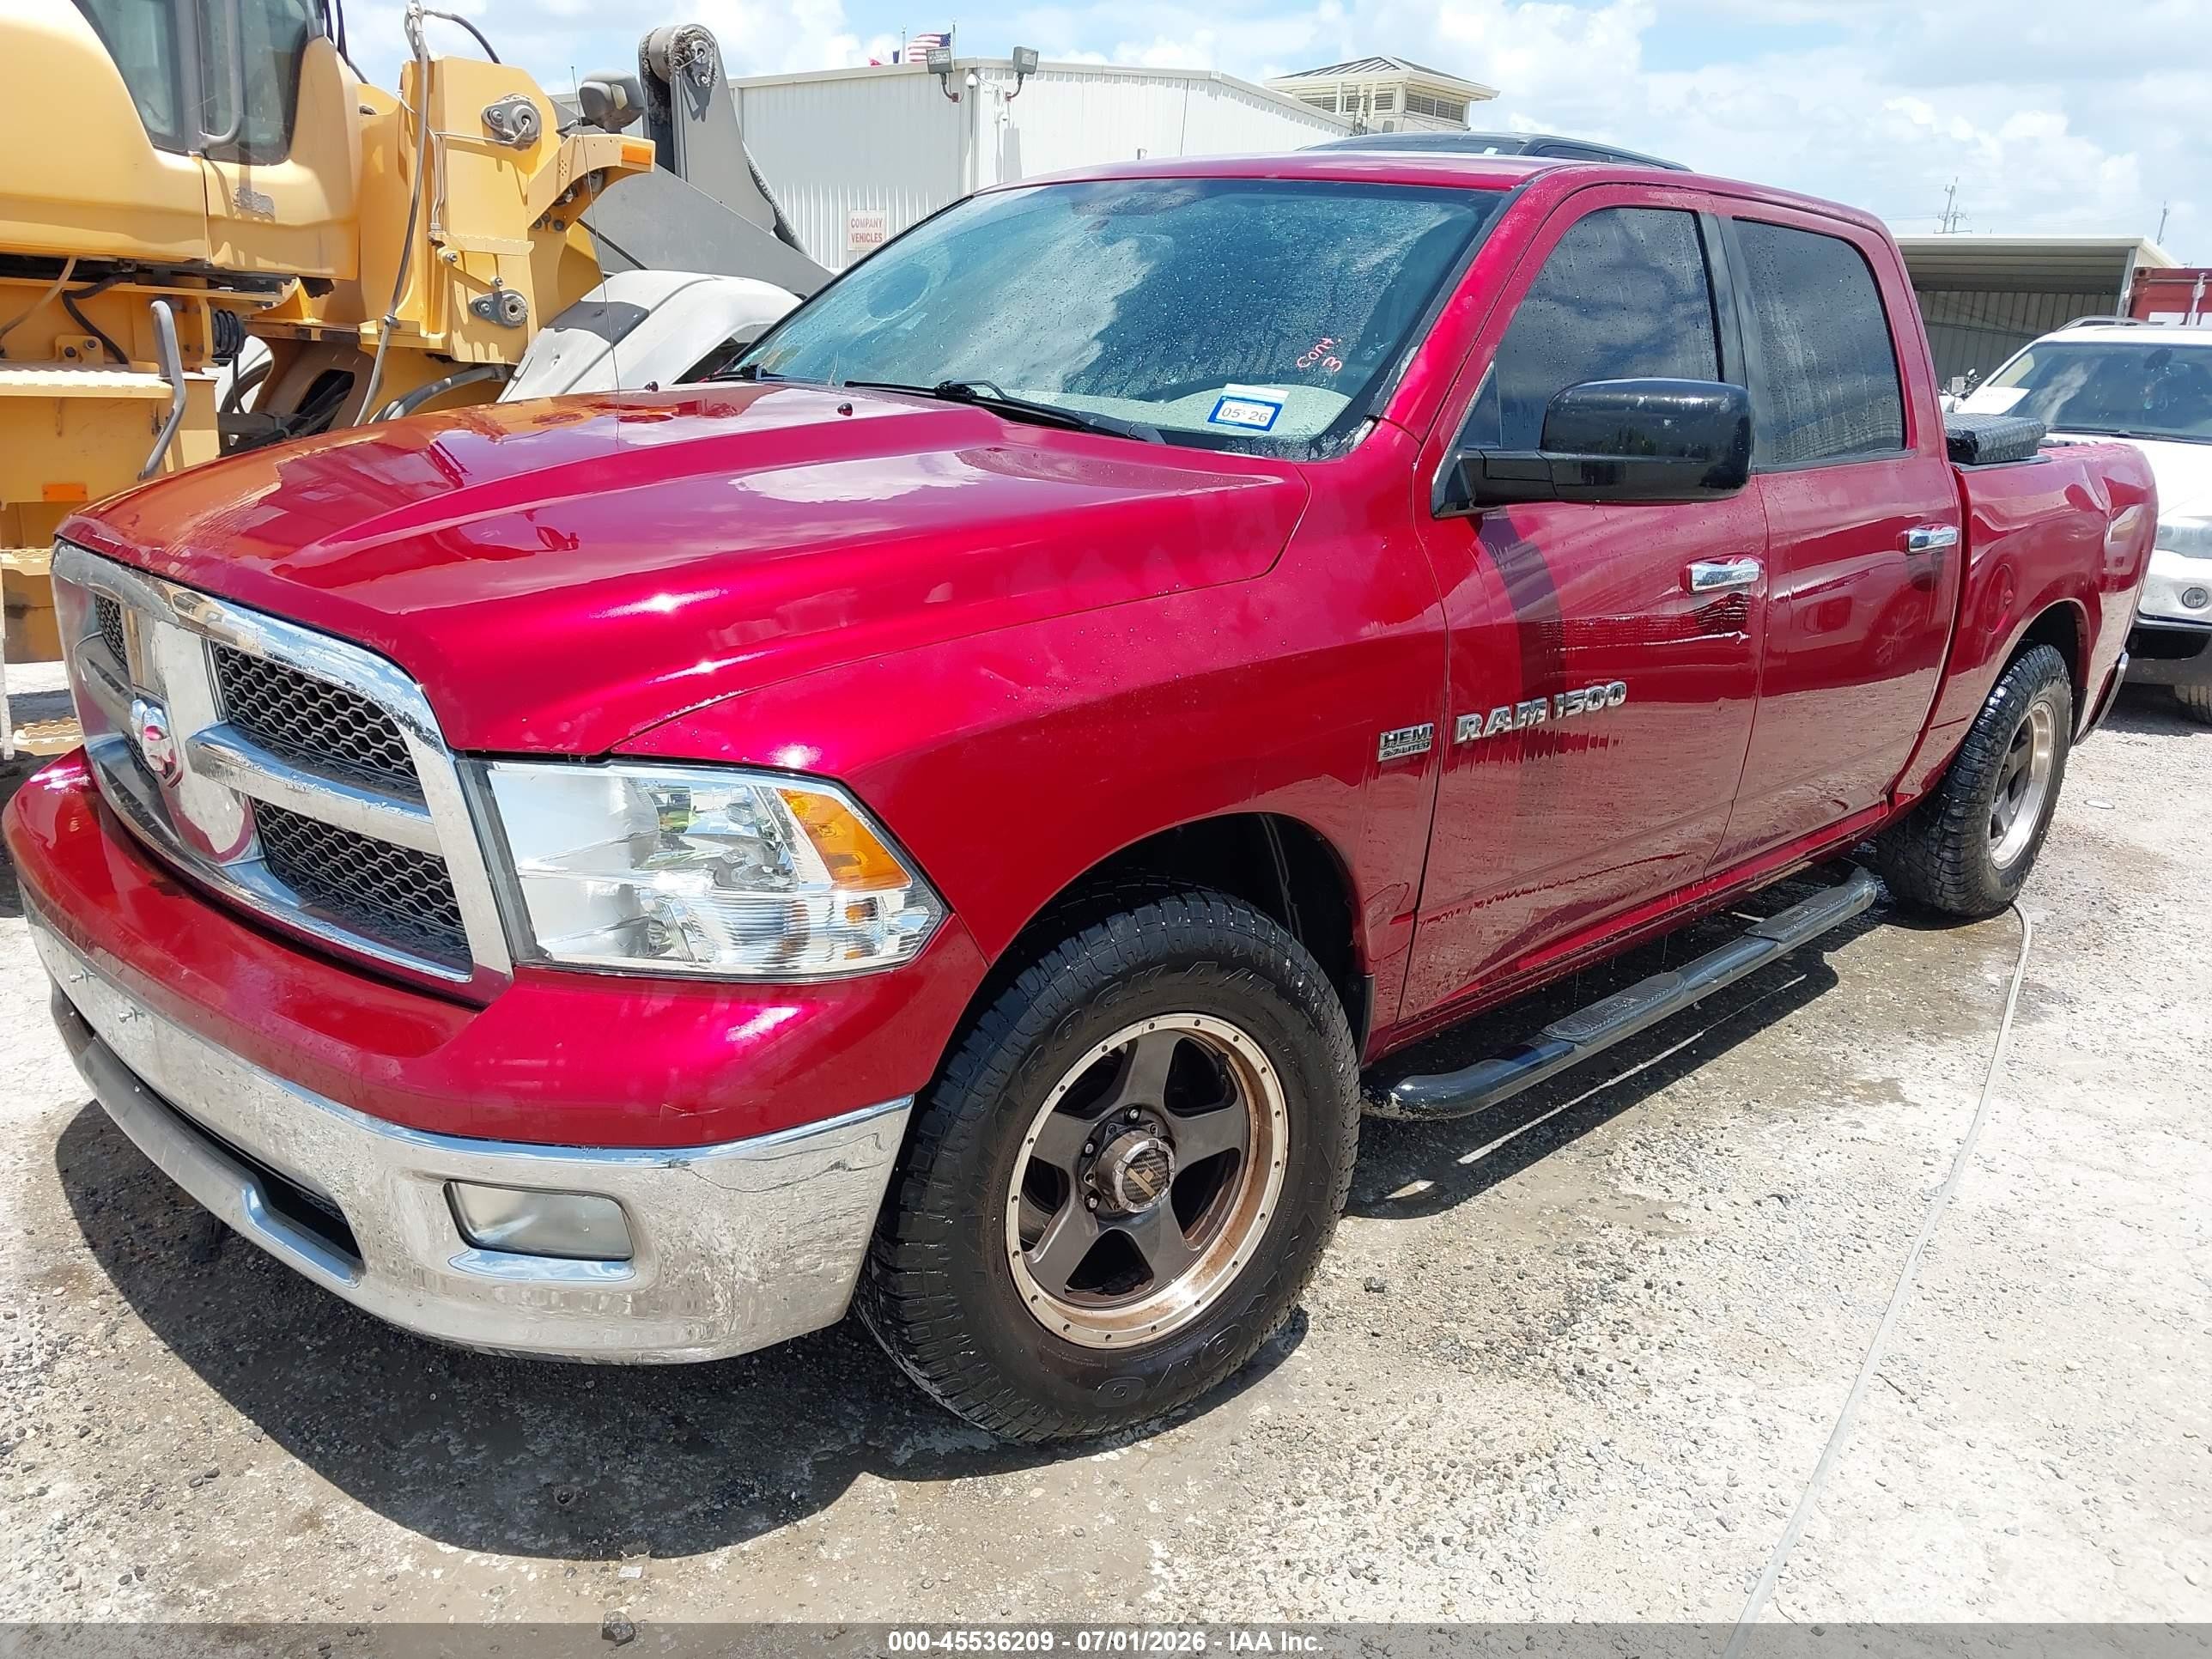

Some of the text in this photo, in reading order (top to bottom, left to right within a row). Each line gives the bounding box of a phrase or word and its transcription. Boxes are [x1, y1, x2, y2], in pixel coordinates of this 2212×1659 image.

[850, 217, 883, 228] COMPANY
[851, 233, 883, 243] VEHICLES
[1454, 681, 1626, 744] RAM 1500
